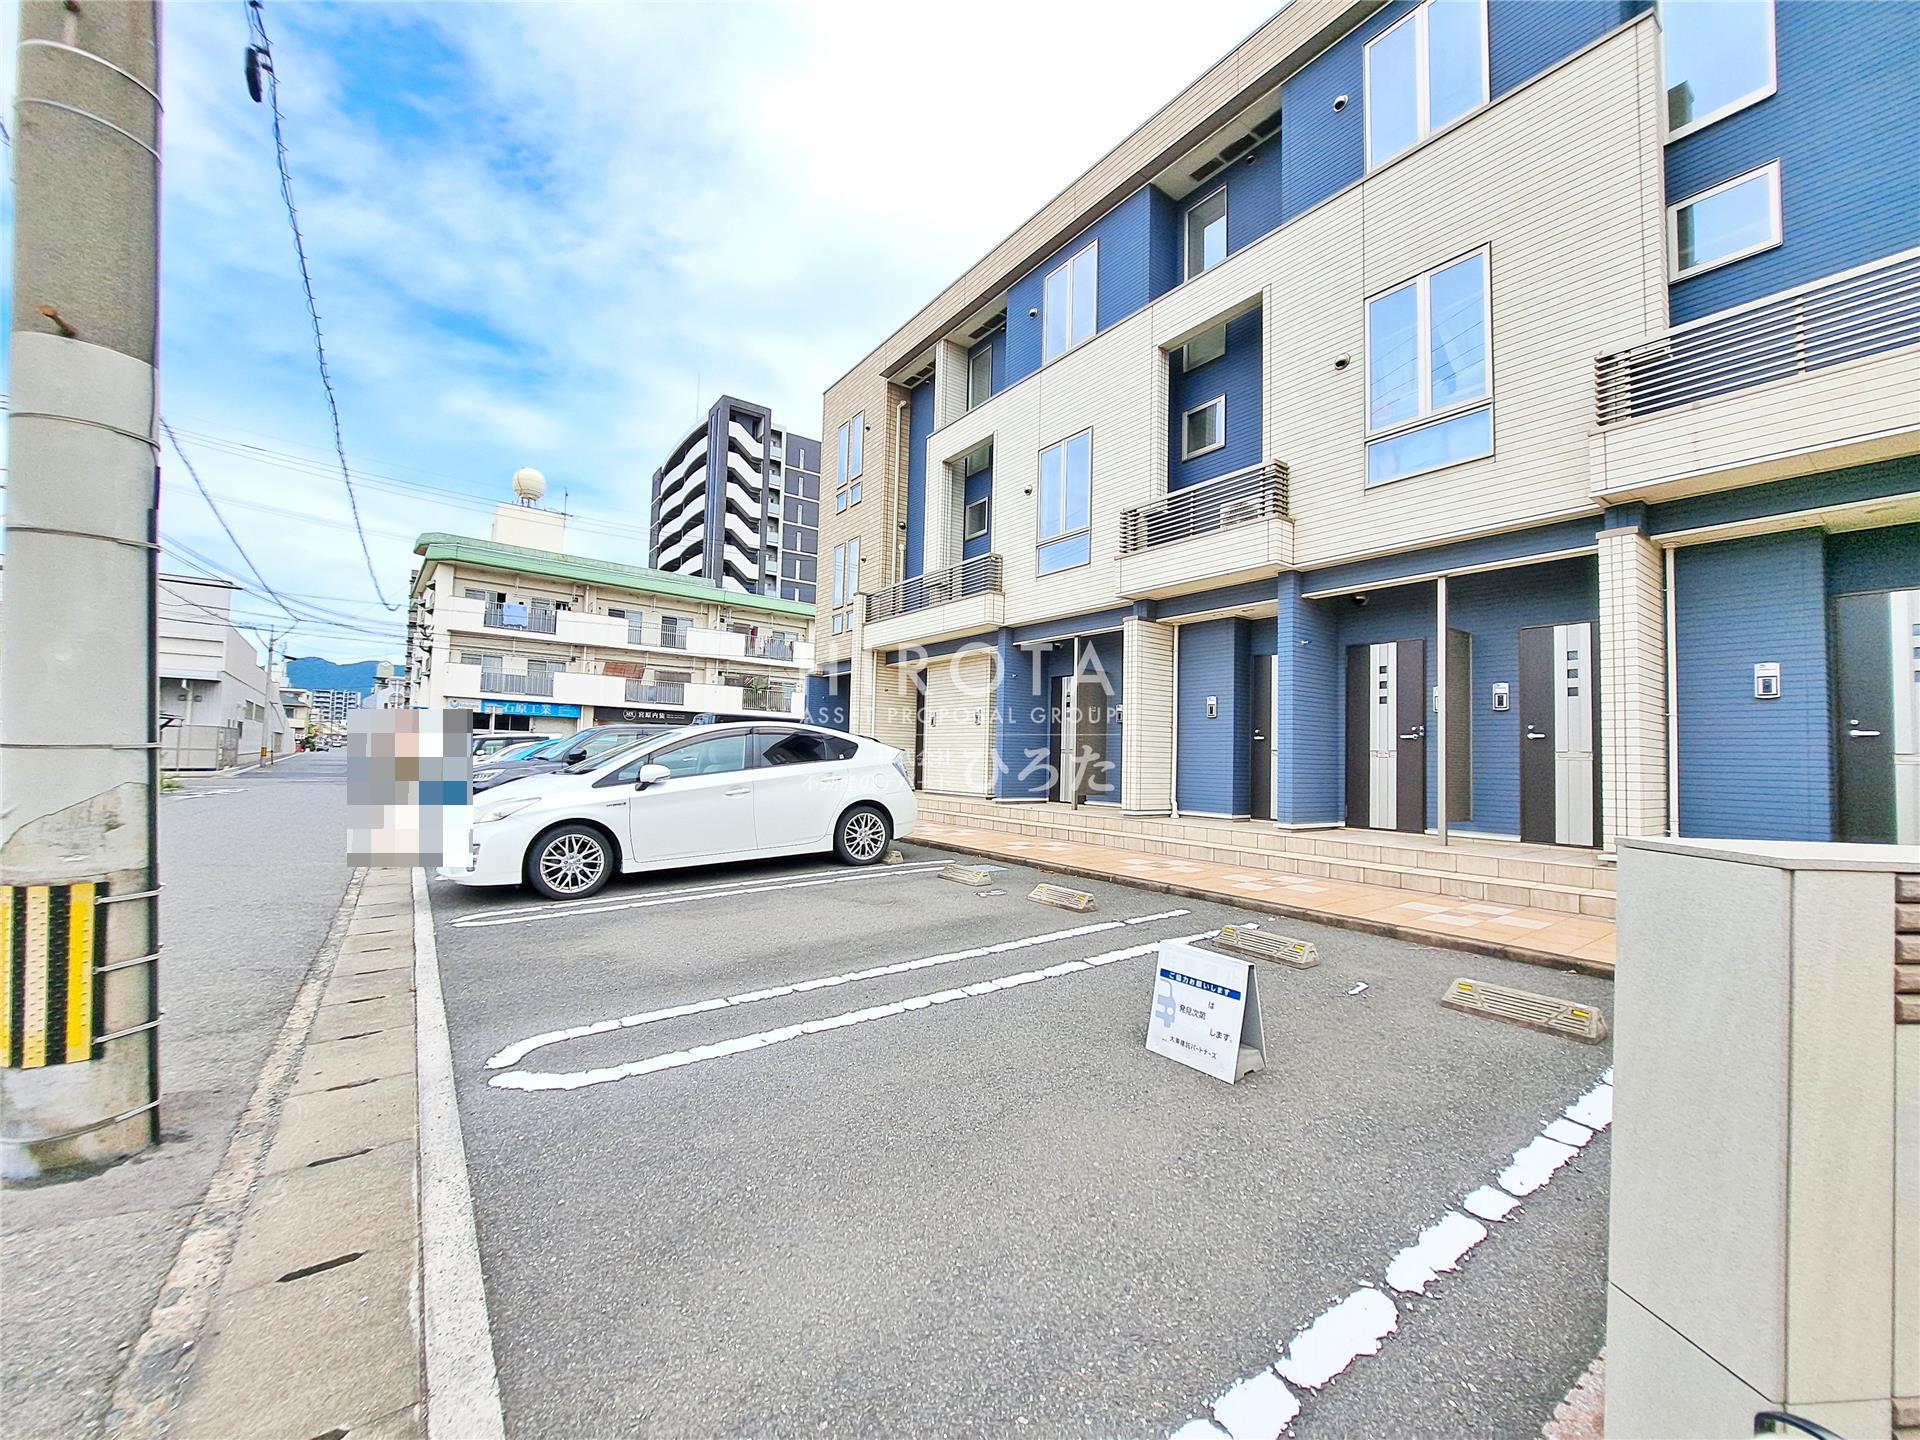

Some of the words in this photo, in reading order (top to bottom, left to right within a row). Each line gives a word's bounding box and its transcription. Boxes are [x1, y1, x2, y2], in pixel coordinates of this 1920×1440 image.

[504, 703, 551, 715] 石原工業
[1208, 1001, 1215, 1010] は
[1178, 1004, 1207, 1021] 発見次第
